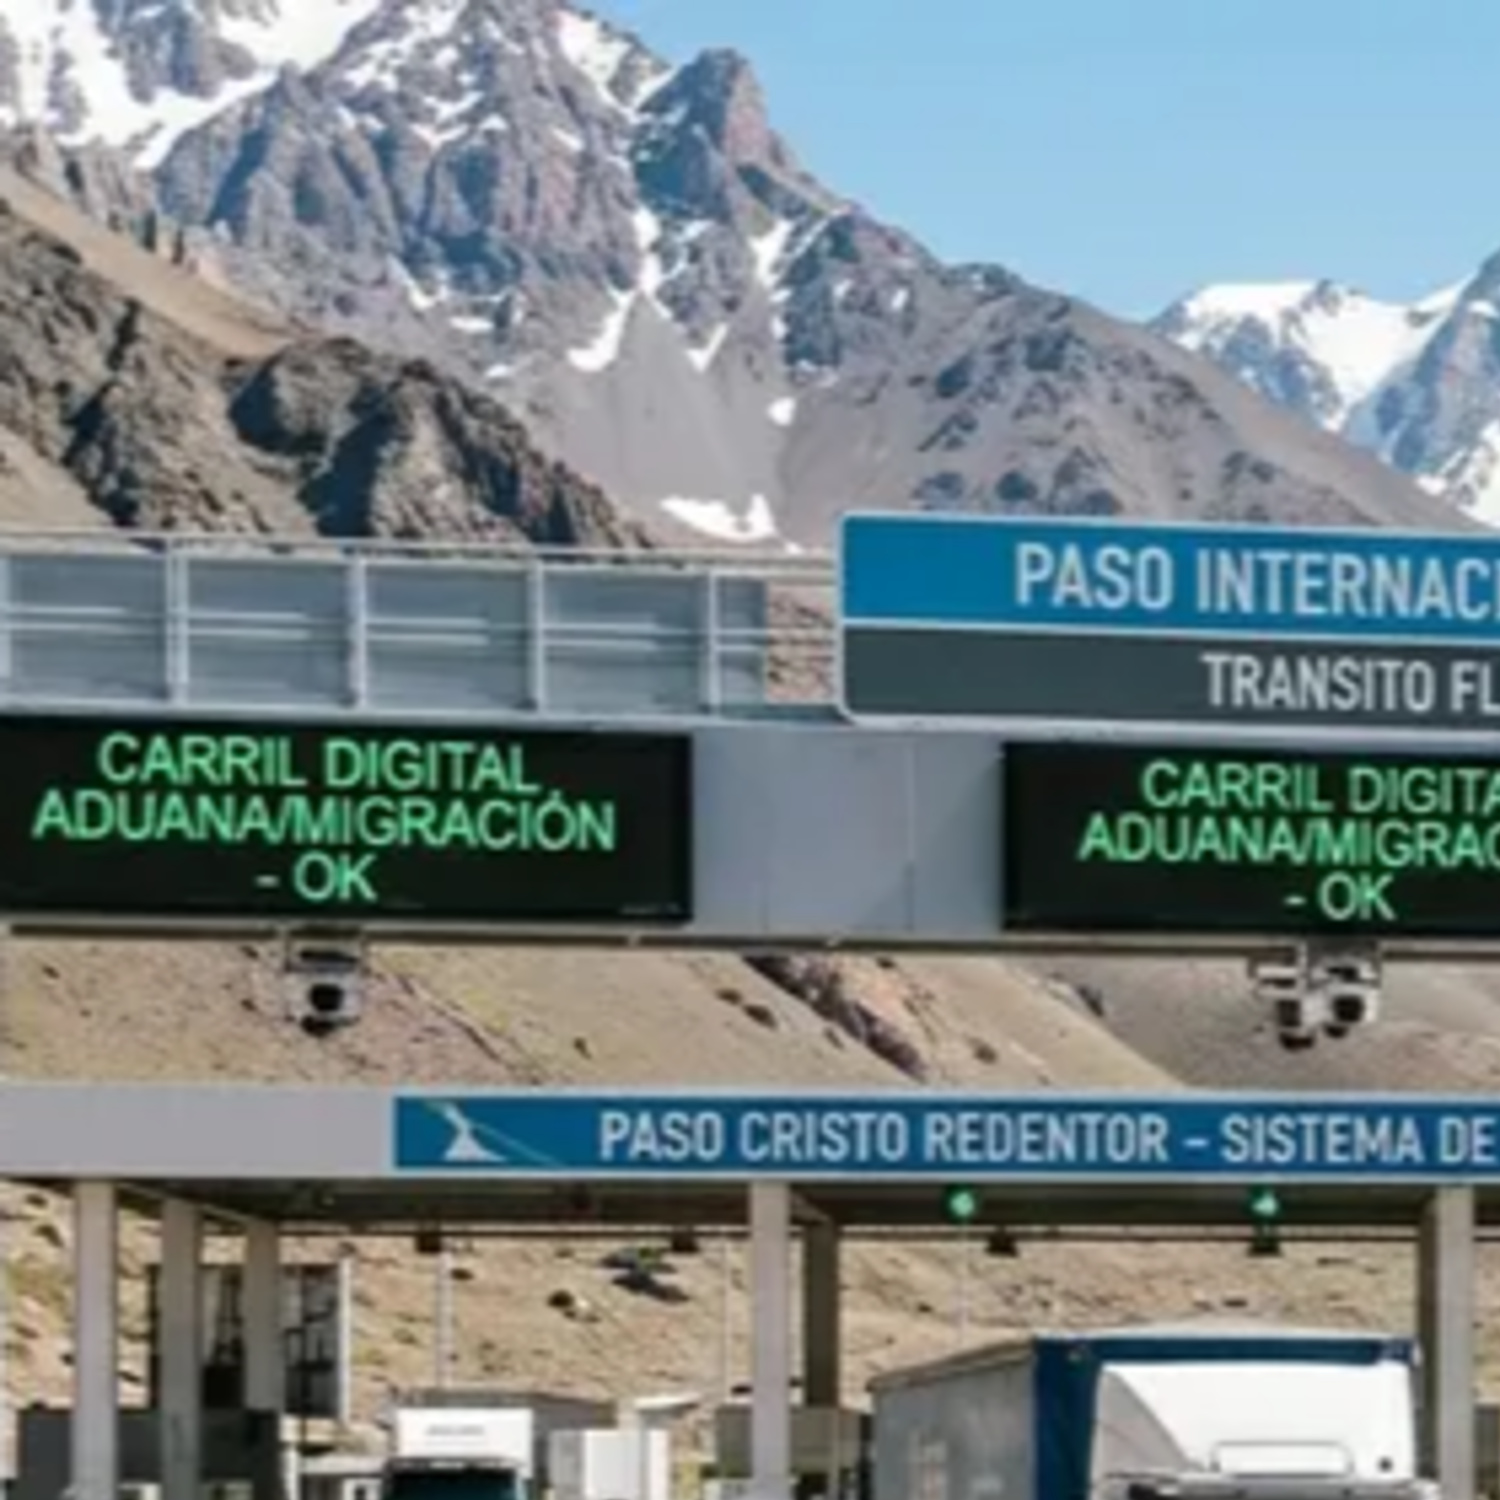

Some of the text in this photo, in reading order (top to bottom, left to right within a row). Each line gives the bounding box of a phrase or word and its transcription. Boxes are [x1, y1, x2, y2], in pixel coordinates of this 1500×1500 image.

[1018, 543, 1172, 610] PASO
[1202, 653, 1434, 712] TRANSITO
[97, 731, 542, 795] CARRIL DIGITAL
[1141, 759, 1334, 813] CARRIL
[31, 787, 616, 854] ADUANA/MIGRACIÓN
[293, 849, 378, 902] OK
[1317, 869, 1396, 921] OK
[602, 1112, 722, 1159] PASO
[741, 1112, 907, 1160] CRISTO
[925, 1112, 1168, 1162] REDENTOR
[1223, 1115, 1424, 1163] SISTEMA
[1440, 1117, 1495, 1164] DE
